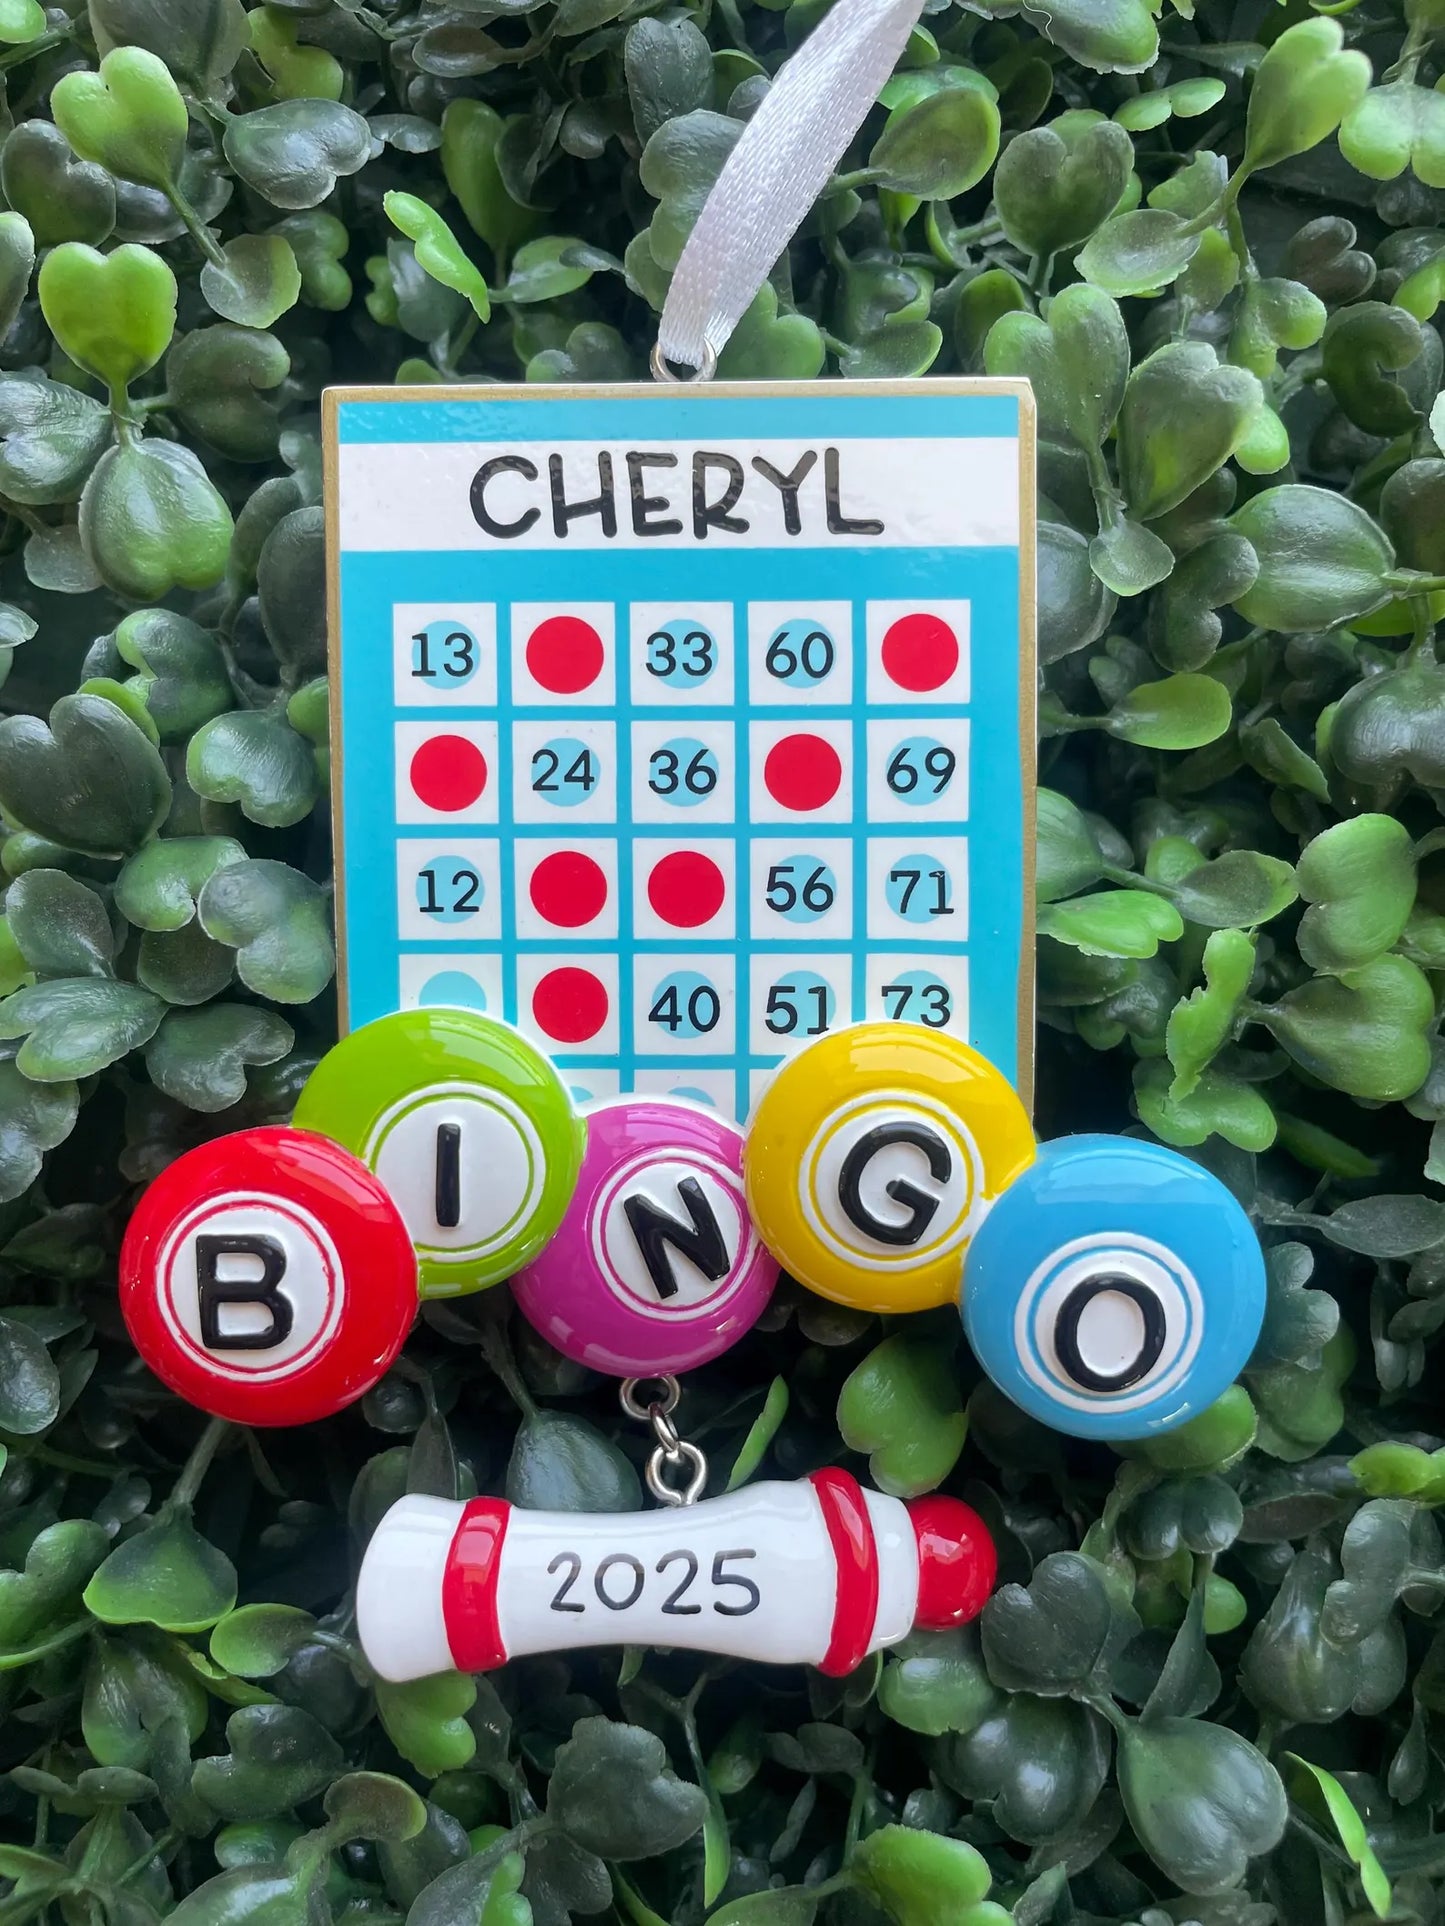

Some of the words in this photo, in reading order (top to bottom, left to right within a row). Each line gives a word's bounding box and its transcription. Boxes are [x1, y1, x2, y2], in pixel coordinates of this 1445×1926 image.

[470, 448, 885, 538] CHERYL
[410, 632, 473, 677] 13
[645, 632, 713, 677] 33
[766, 632, 834, 679] 60
[532, 750, 595, 791] 24
[649, 749, 717, 795] 36
[887, 748, 956, 794] 69
[418, 870, 480, 914] 12
[766, 867, 834, 914] 56
[891, 870, 955, 915] 71
[648, 985, 721, 1033] 40
[765, 985, 830, 1035] 51
[881, 984, 951, 1028] 73
[547, 1548, 761, 1617] 2025
